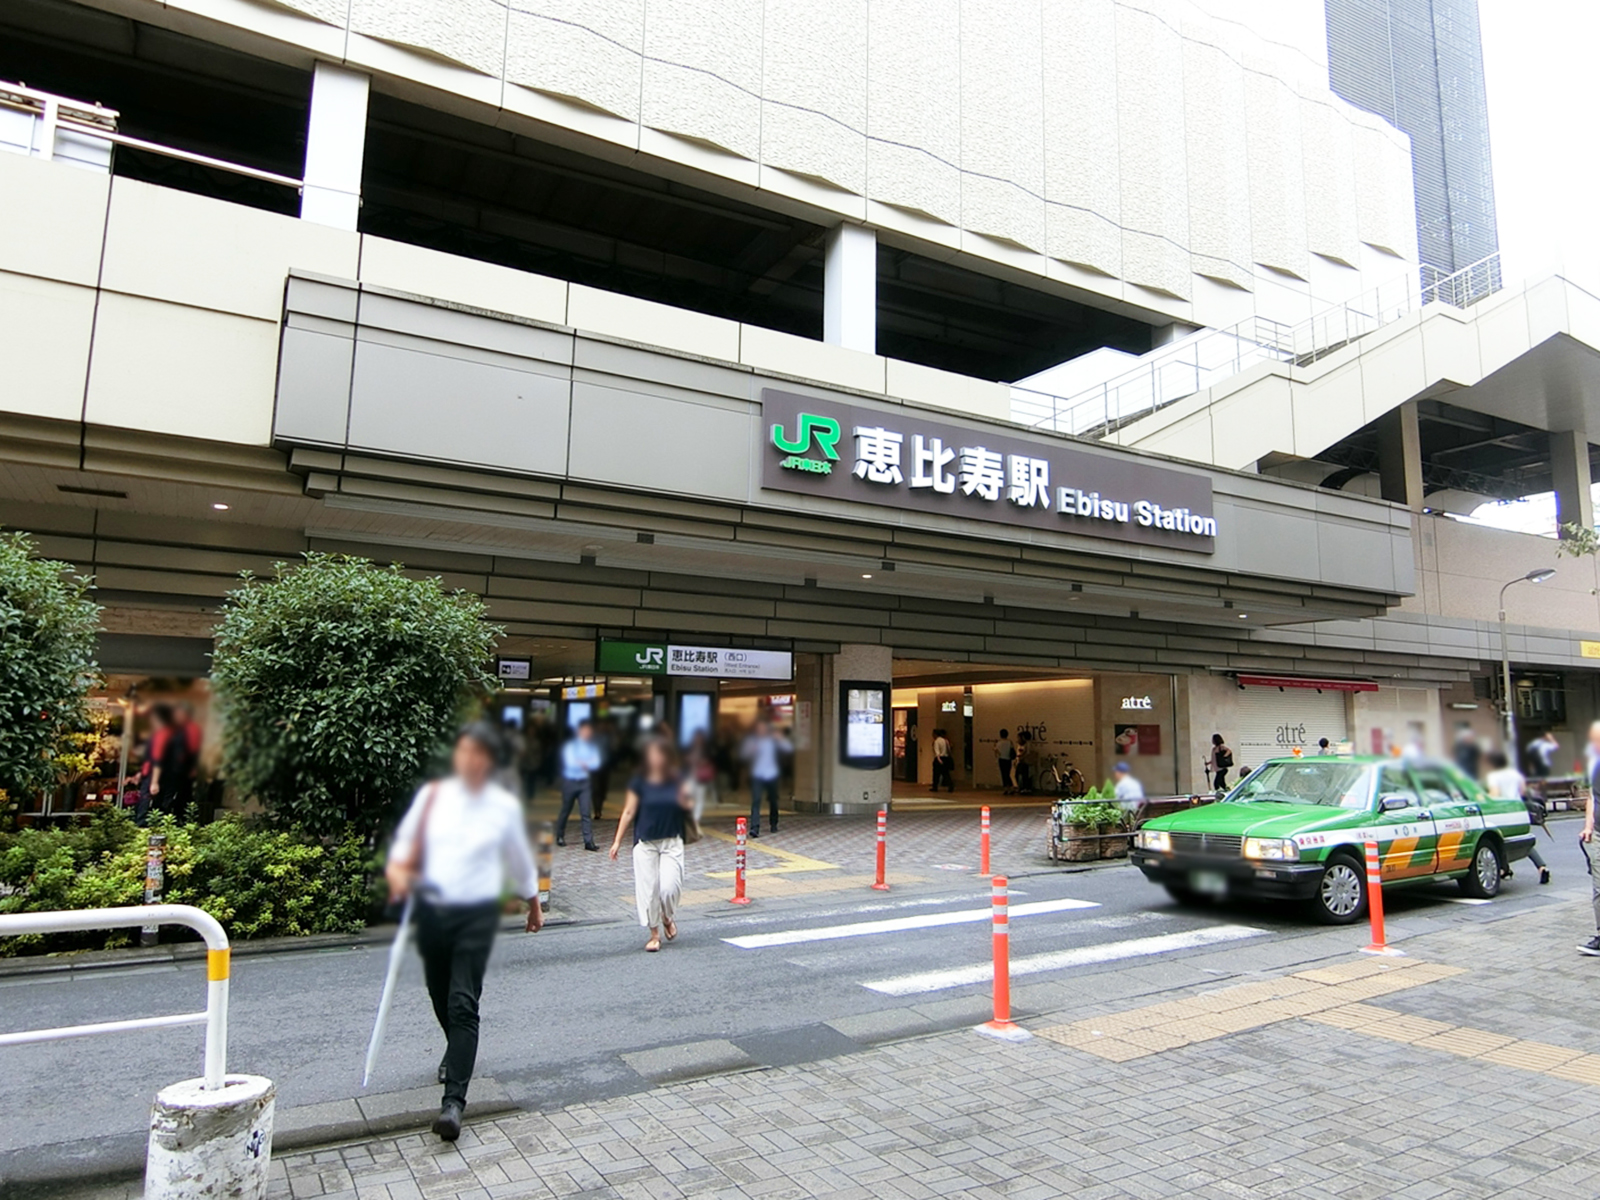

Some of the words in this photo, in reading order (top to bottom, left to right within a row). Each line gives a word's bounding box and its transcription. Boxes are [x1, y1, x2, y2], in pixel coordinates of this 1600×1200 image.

[770, 412, 841, 460] JR
[852, 426, 1051, 509] 恵比寿駅
[1057, 487, 1129, 523] Ebisu
[1134, 500, 1217, 537] Station
[636, 647, 664, 665] JR
[672, 649, 718, 664] 恵比寿駅
[671, 664, 691, 672] Ebisu
[693, 664, 719, 674] Station
[1122, 695, 1152, 709] atré
[1276, 722, 1306, 743] atré
